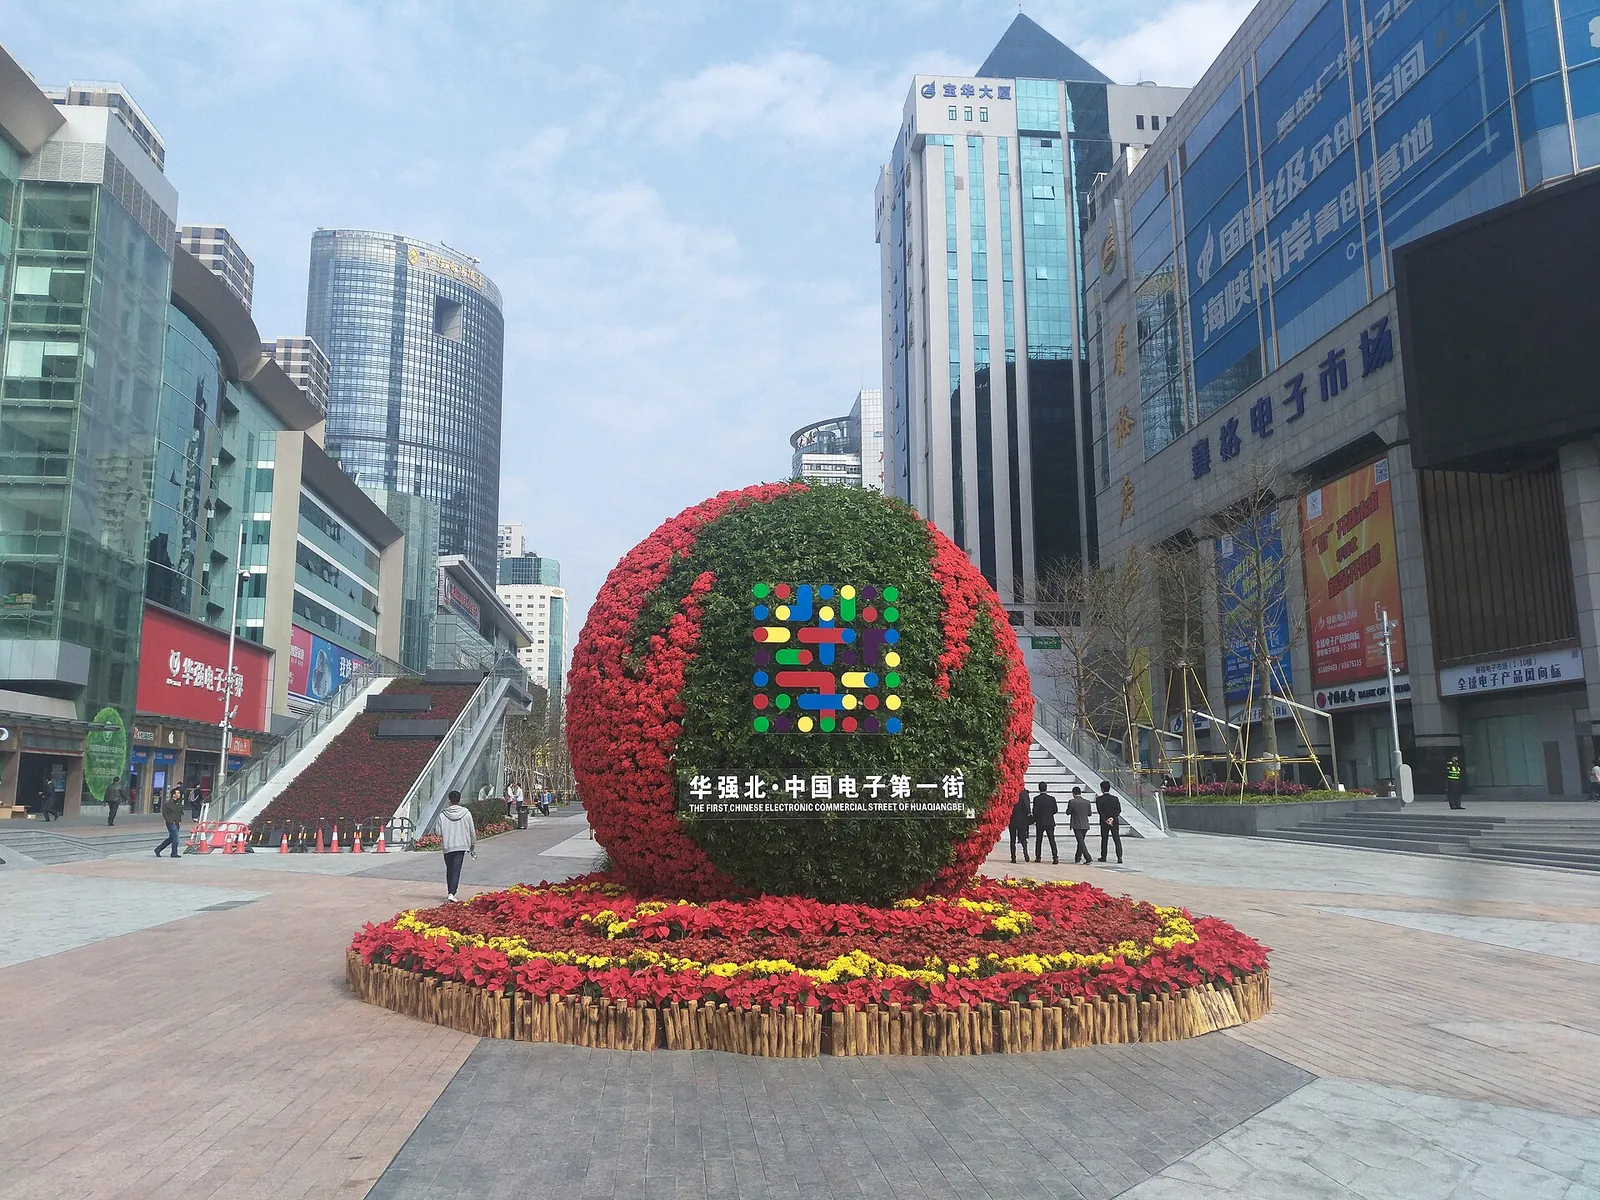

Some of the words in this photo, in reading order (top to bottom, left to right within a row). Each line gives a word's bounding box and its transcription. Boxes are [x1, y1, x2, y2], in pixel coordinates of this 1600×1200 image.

[942, 82, 1012, 101] 宝华大厦
[1219, 40, 1426, 267] 国家级众创空间
[1202, 114, 1434, 342] 海峡两岸青创基地
[1191, 316, 1394, 480] 赛格电子市场
[1457, 663, 1562, 691] 全球电子产品风向标
[1327, 688, 1356, 705] 中国银行
[1358, 687, 1377, 699] BANK
[1376, 686, 1386, 696] OF
[688, 768, 966, 800] 华强北·中国电子第一街
[689, 803, 704, 812] THE
[706, 803, 729, 812] FIRST
[729, 803, 764, 812] CHINESE
[764, 803, 813, 812] ELECTRONIC
[814, 803, 867, 812] COMMERCIAL
[868, 803, 898, 812] STREET
[898, 803, 909, 812] OF
[910, 803, 965, 812] HUAQIANGBEI
